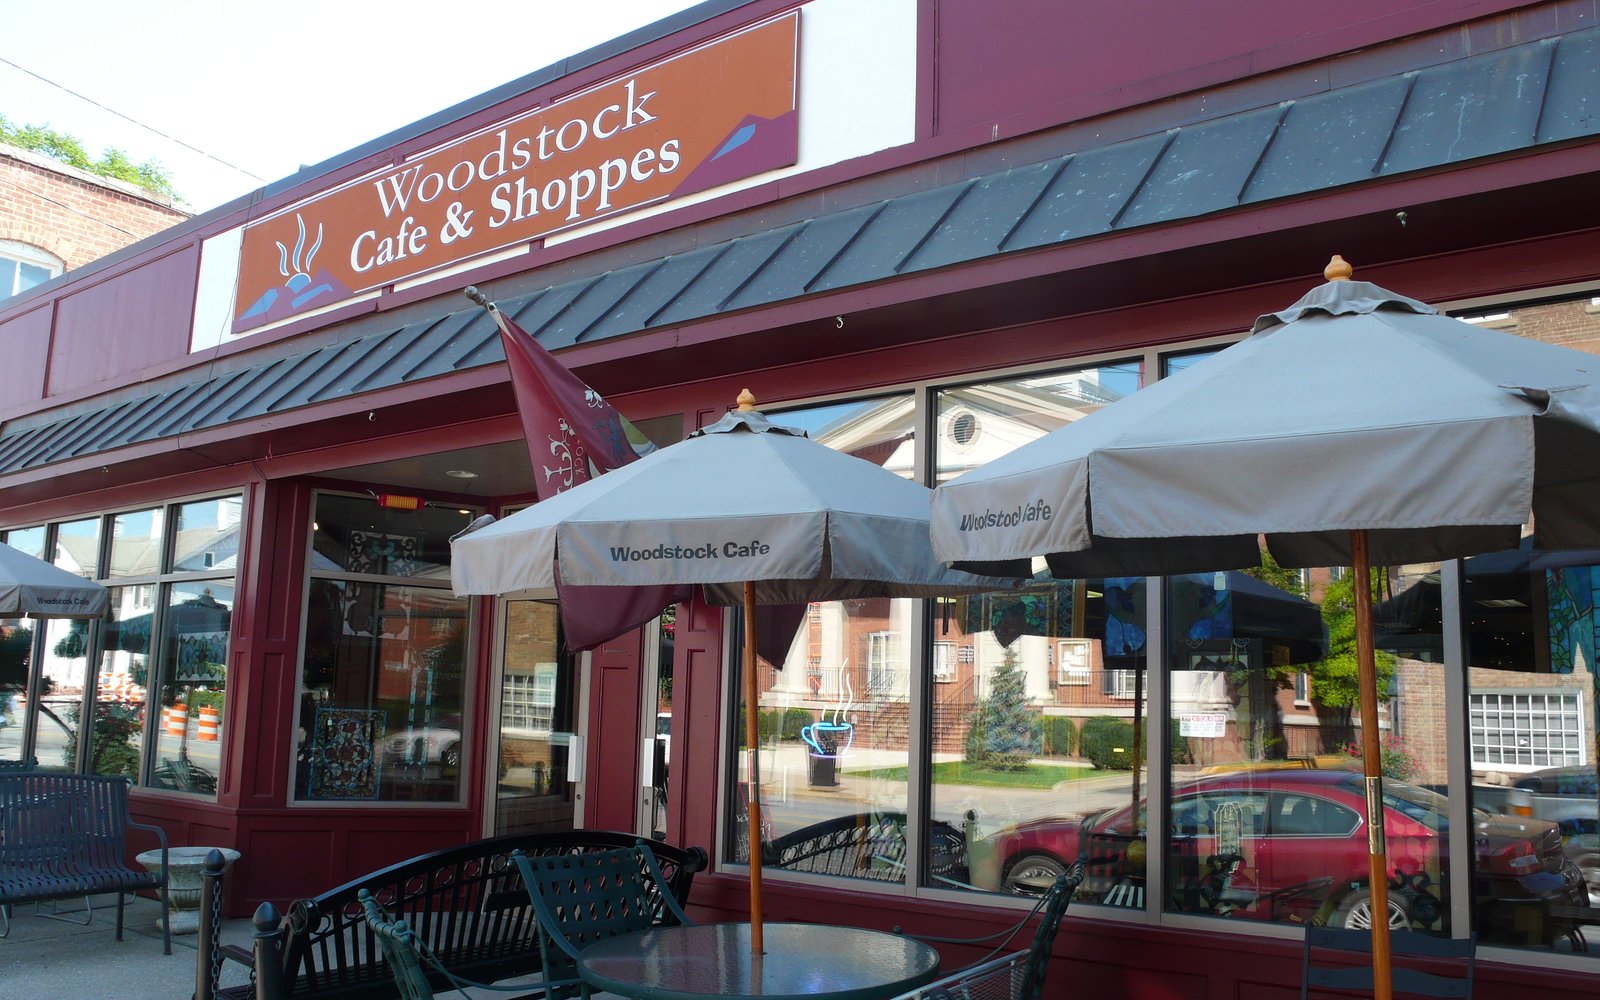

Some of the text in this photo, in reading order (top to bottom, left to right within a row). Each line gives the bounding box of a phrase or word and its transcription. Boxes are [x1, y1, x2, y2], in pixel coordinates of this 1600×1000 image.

[374, 80, 658, 219] Woodstock
[350, 139, 682, 273] Cafe & Shoppes
[610, 540, 770, 562] Woodstock Cafe
[37, 597, 90, 605] Woodstock Cafe
